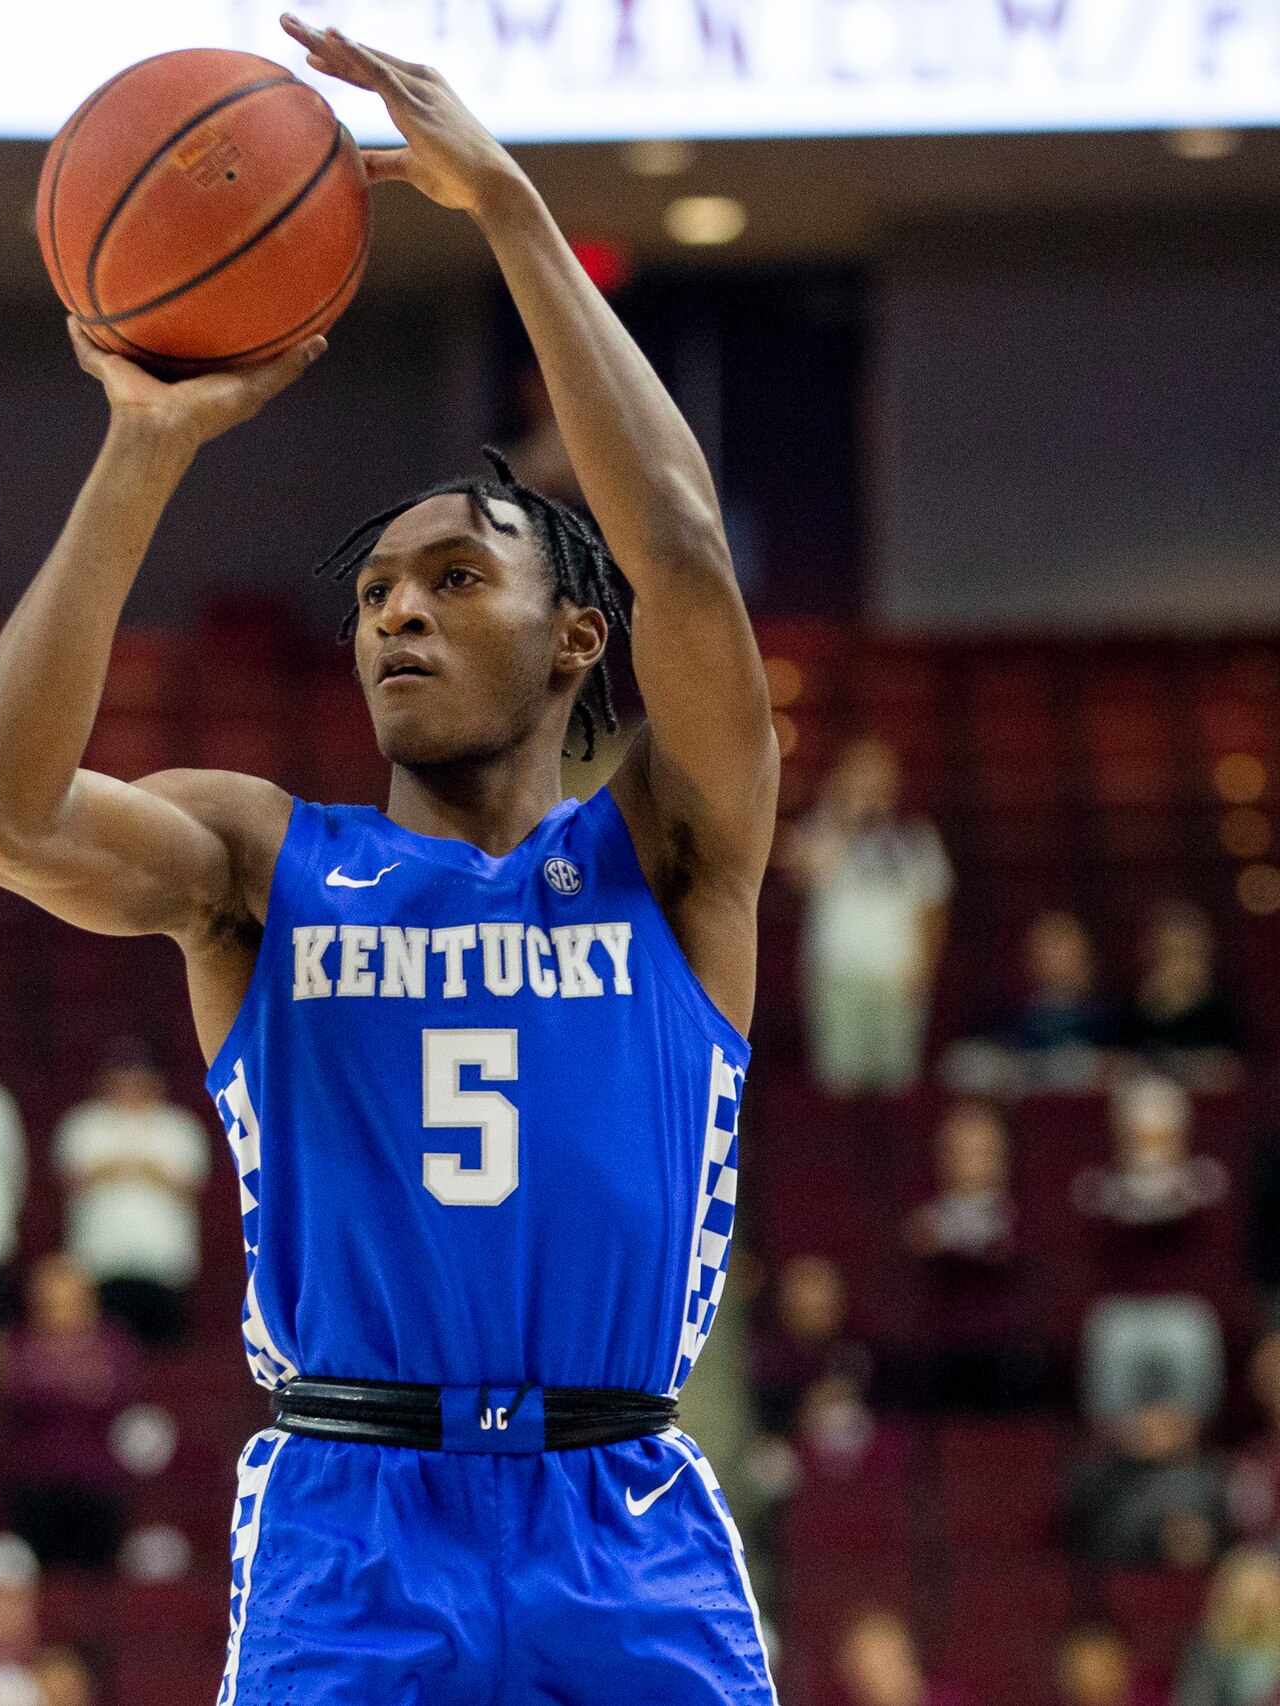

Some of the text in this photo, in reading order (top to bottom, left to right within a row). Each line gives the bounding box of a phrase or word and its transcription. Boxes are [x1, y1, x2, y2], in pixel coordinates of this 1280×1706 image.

[547, 860, 580, 891] SEC
[292, 922, 633, 1000] KENTUCKY
[422, 1028, 519, 1206] 5
